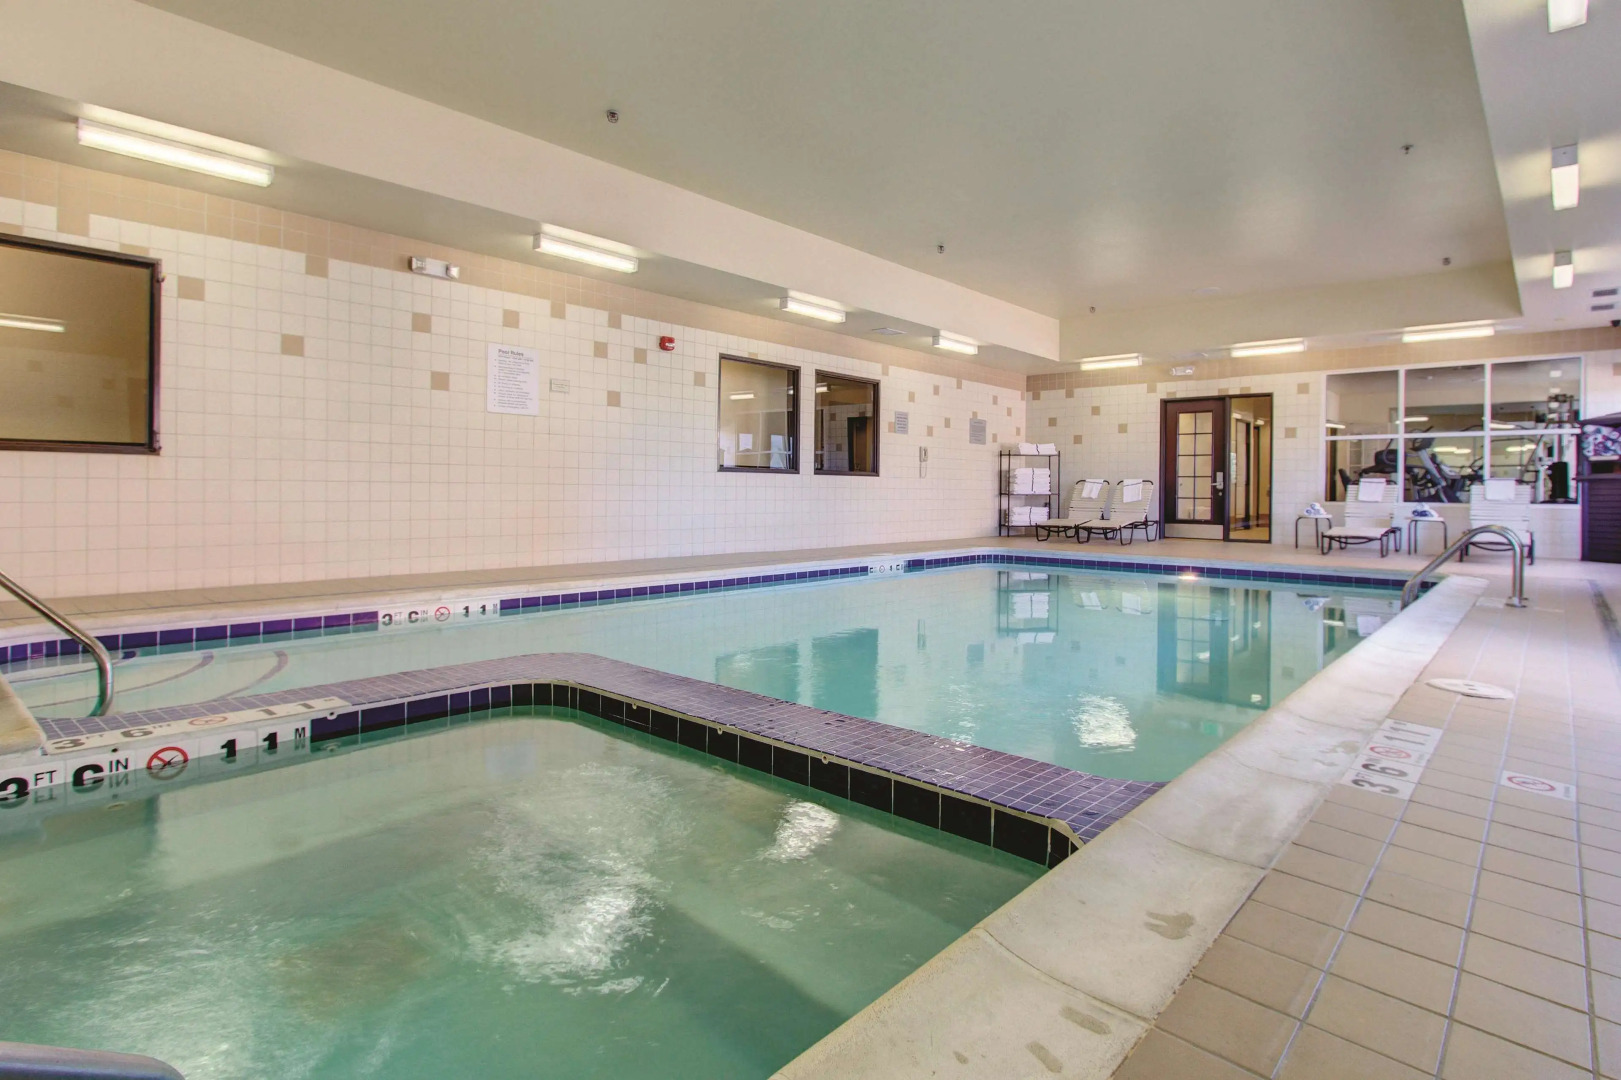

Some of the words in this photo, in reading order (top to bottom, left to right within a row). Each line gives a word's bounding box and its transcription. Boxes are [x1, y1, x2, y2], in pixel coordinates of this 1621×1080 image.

[120, 727, 154, 738] 6
[33, 769, 57, 787] FT
[107, 757, 129, 774] IN
[294, 726, 306, 740] M
